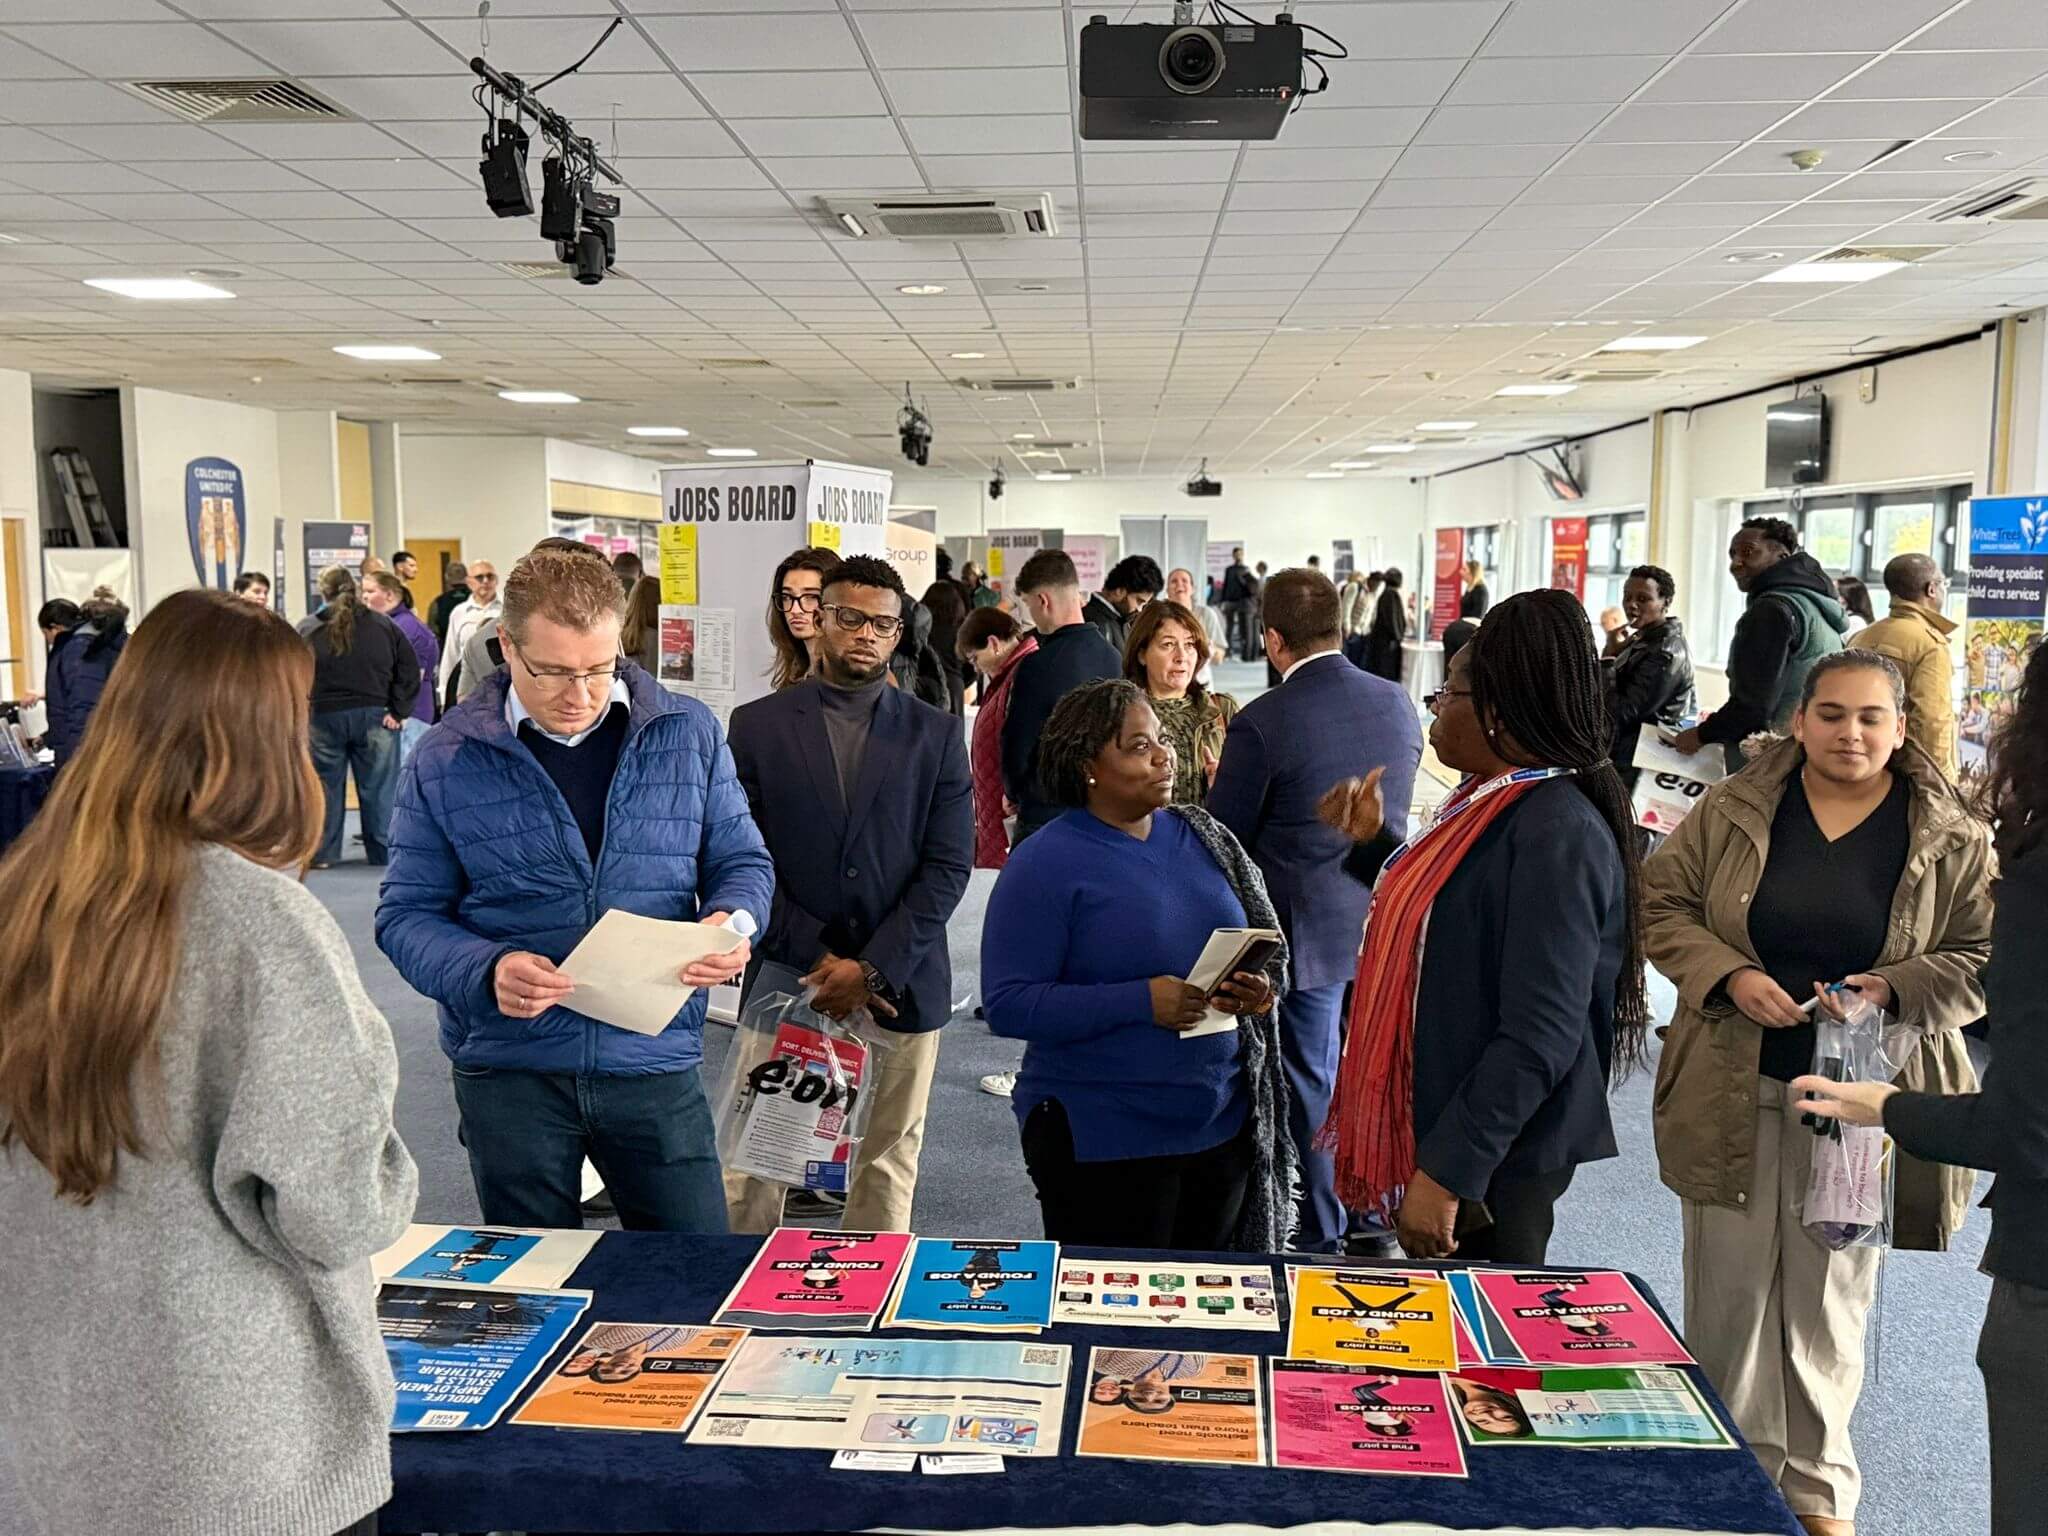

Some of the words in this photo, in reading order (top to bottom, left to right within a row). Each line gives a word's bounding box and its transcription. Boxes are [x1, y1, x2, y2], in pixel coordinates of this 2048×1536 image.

[193, 467, 237, 481] COLCHESTER
[669, 486, 720, 522] JOBS
[728, 484, 797, 522] BOARD
[817, 485, 848, 522] JOBS
[991, 535, 1011, 548] JOBS
[1013, 535, 1039, 548] BOARD
[1968, 565, 2005, 583] Providing
[2006, 566, 2044, 583] specialist
[1967, 585, 1986, 599] child
[1987, 588, 2005, 600] care
[2006, 588, 2040, 601] services
[1655, 772, 1706, 797] e.o
[810, 1262, 825, 1270] A
[824, 1261, 880, 1270] FOUND
[978, 1272, 1033, 1280] FOUND
[1317, 1308, 1352, 1316] JOB
[1353, 1310, 1367, 1318] A
[1368, 1310, 1428, 1319] FOUND
[1519, 1308, 1552, 1317] JOB
[1552, 1307, 1567, 1315] A
[1569, 1305, 1628, 1315] FOUND
[434, 1375, 446, 1384] &
[445, 1377, 499, 1387] SKILLS
[421, 1393, 484, 1404] MIDLIFE
[638, 1400, 689, 1408] Schools
[1120, 1420, 1178, 1430] teachers
[1181, 1424, 1211, 1432] than
[1213, 1426, 1249, 1434] more
[1195, 1431, 1249, 1440] Schools
